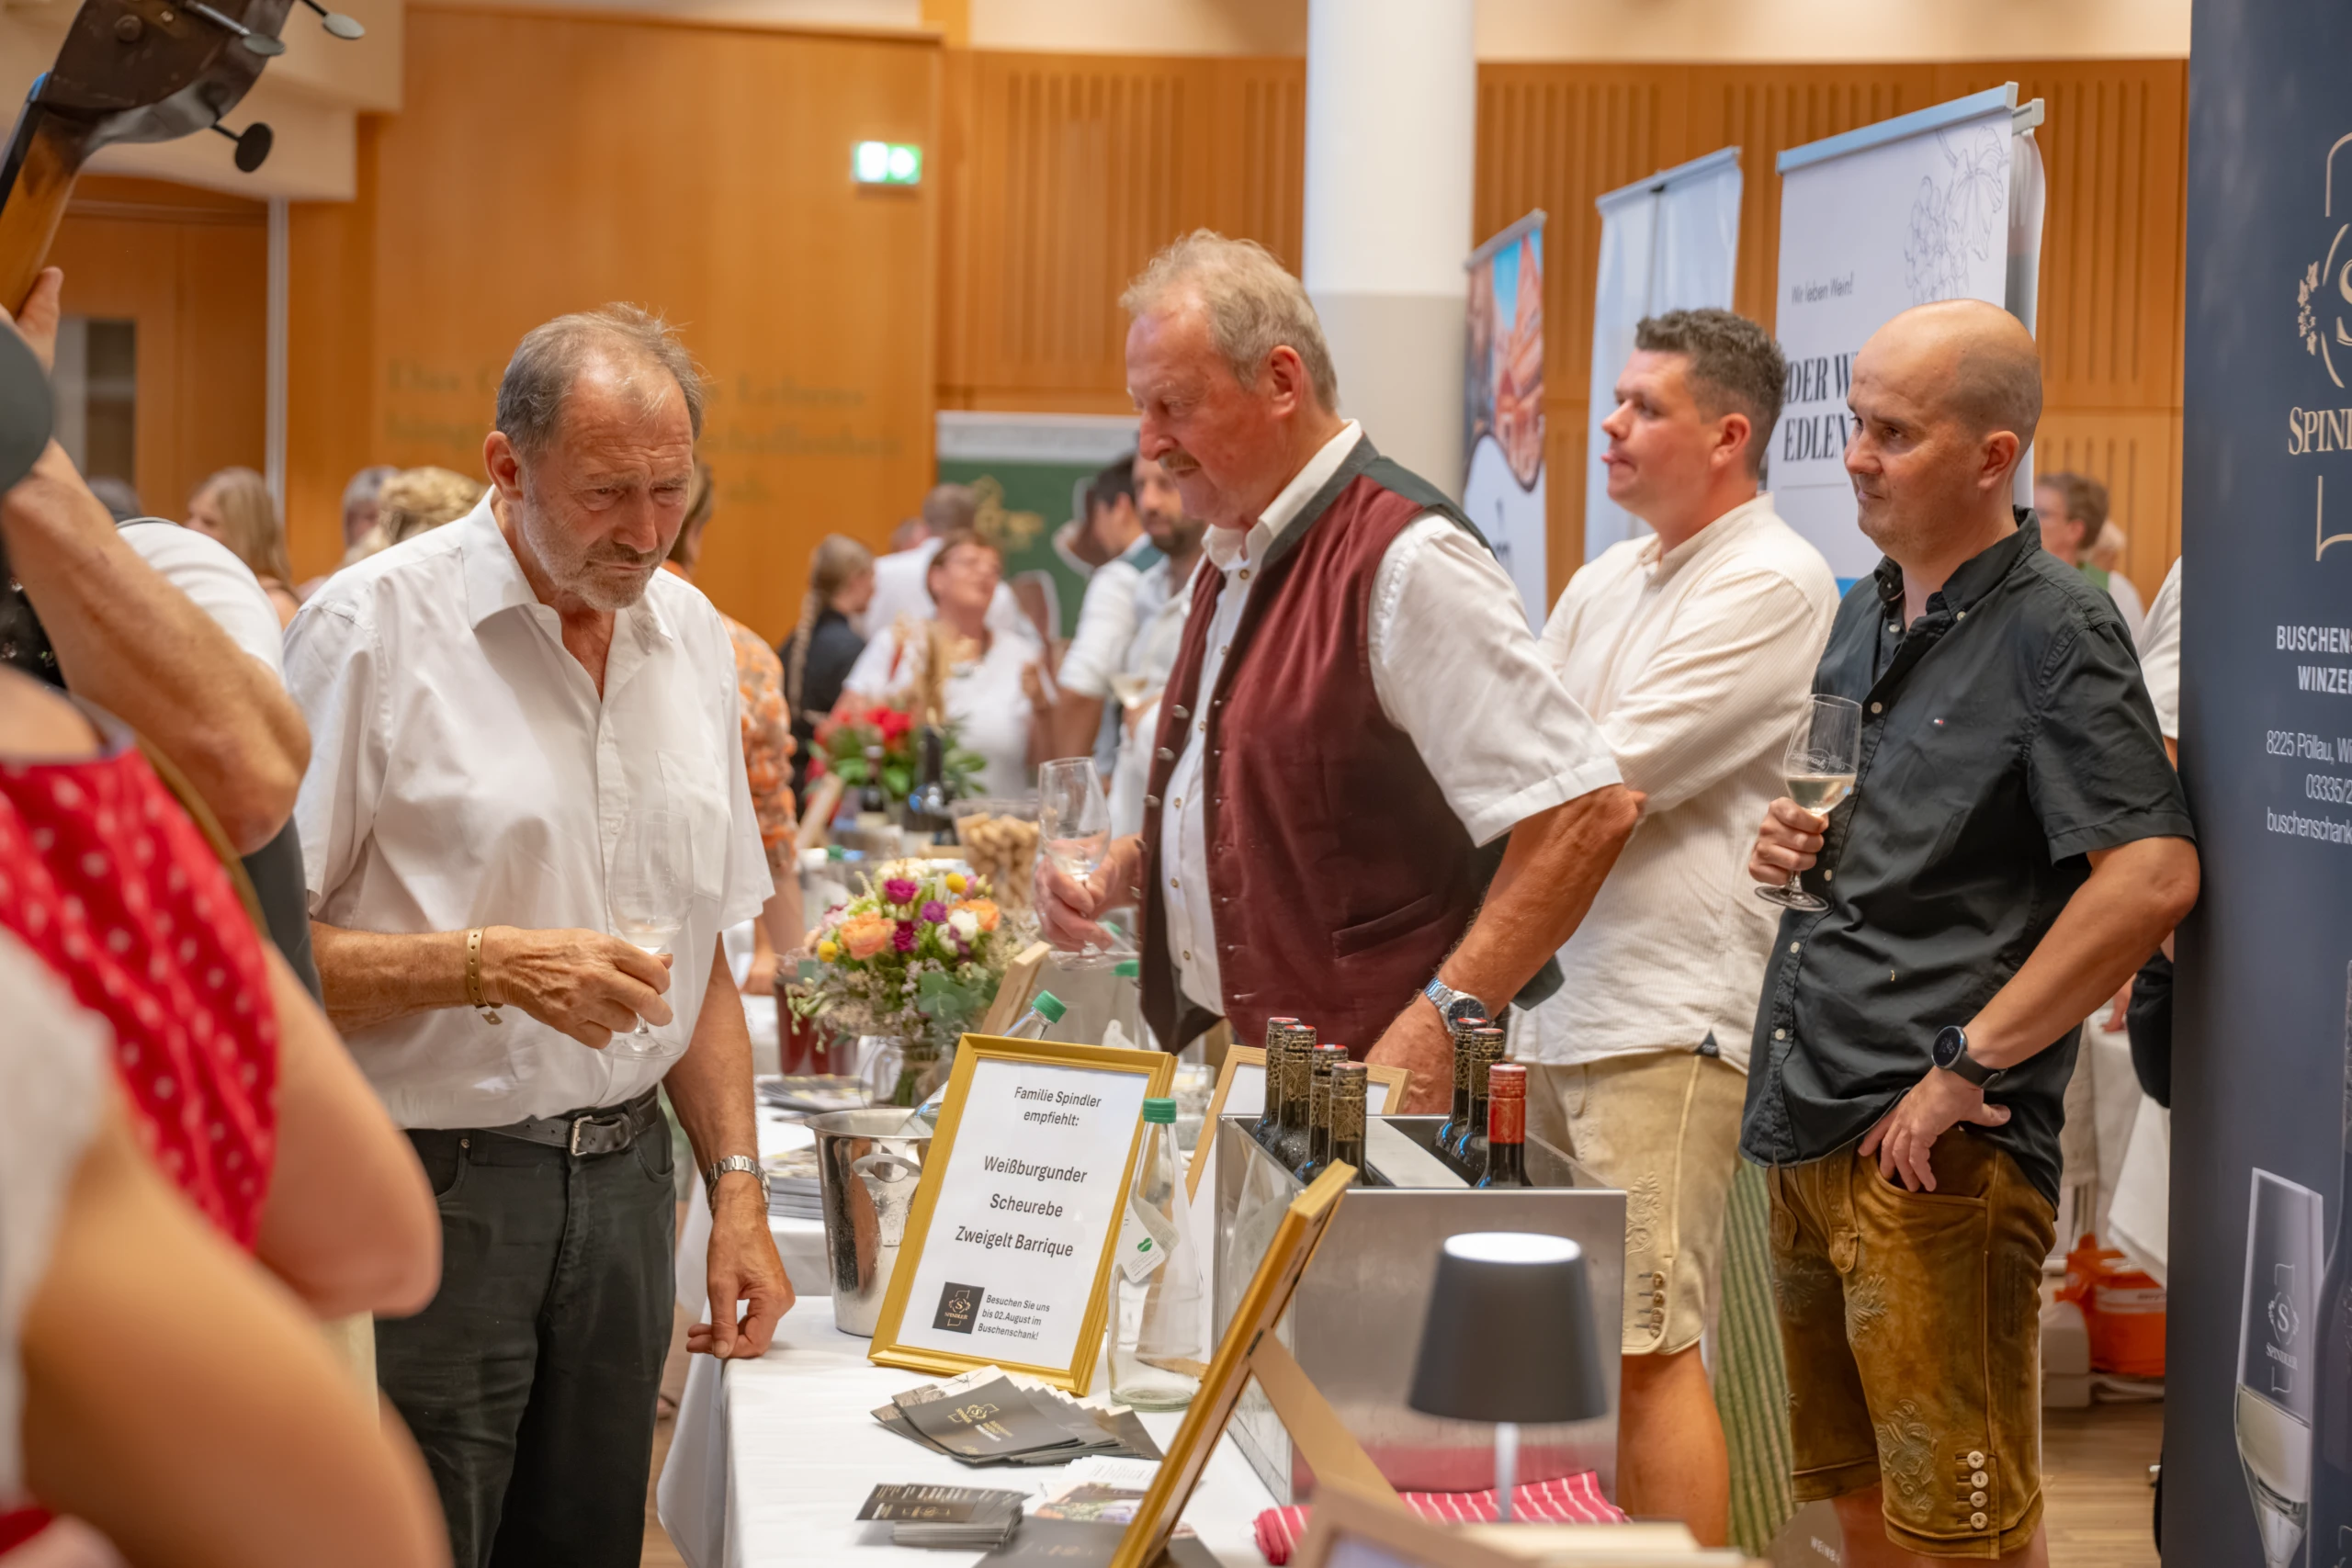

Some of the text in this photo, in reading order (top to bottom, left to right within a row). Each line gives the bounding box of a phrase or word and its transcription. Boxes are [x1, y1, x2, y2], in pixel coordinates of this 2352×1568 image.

[1834, 351, 1858, 400] W
[2288, 406, 2352, 456] SPIN
[2276, 625, 2352, 654] BUSCHEN
[2266, 730, 2295, 757] 8225
[1013, 1086, 1102, 1108] Familie Spindler
[1023, 1111, 1080, 1127] empfiehlt:
[984, 1155, 1088, 1183] Weißburgunder
[989, 1193, 1064, 1218] Scheurebe
[955, 1225, 1074, 1258] Zweigelt Barrique
[981, 1308, 993, 1319] bis
[1031, 1315, 1042, 1325] im
[986, 1294, 1051, 1313] Besuchen Sie uns
[978, 1322, 1039, 1341] Buschenschank!
